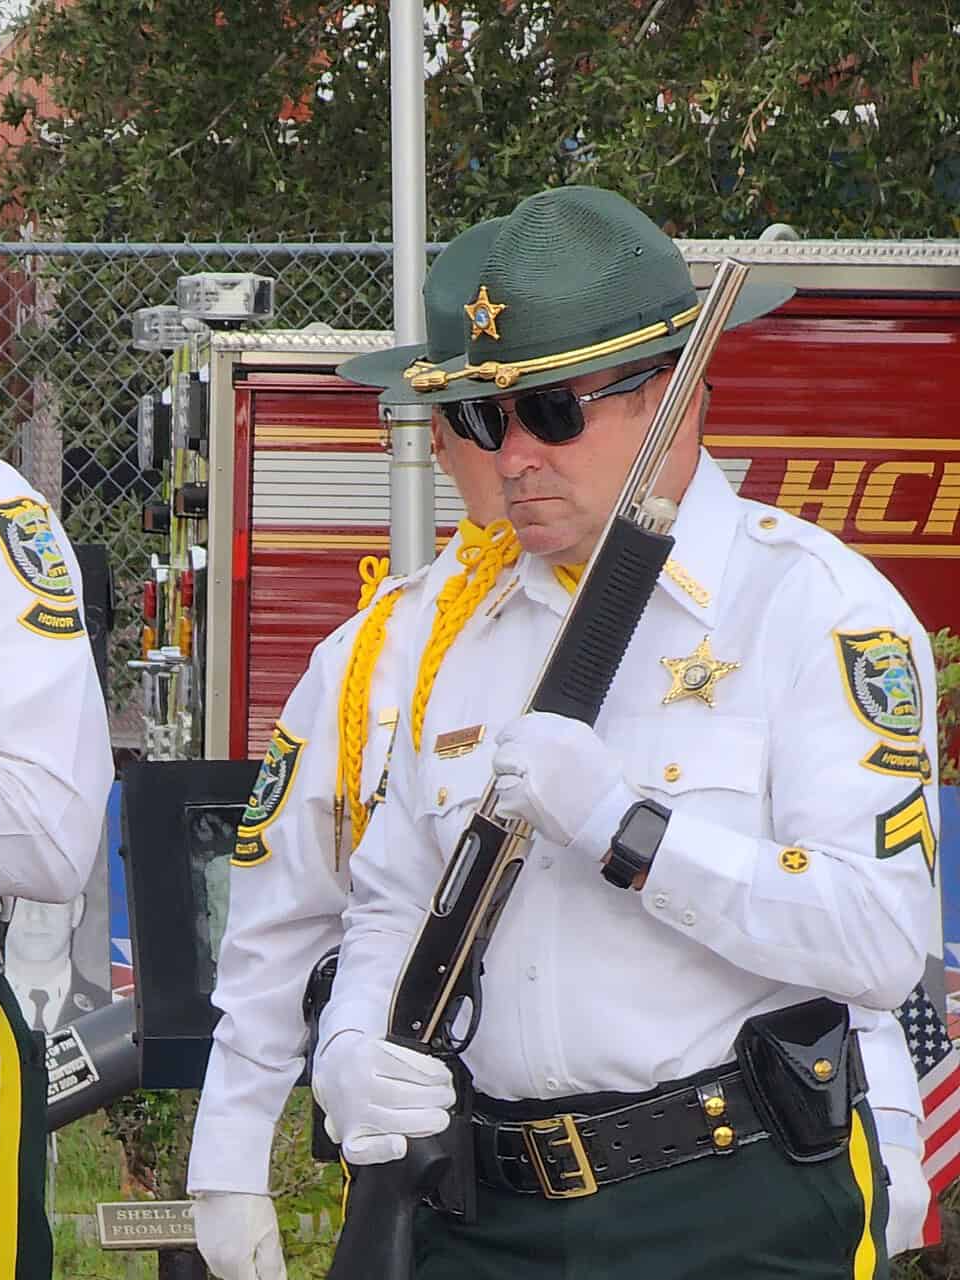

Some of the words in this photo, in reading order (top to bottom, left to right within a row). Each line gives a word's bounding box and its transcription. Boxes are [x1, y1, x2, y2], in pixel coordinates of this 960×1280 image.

[776, 459, 960, 535] HC
[38, 612, 75, 628] HONOR
[882, 752, 918, 767] HONOR
[116, 1208, 177, 1220] SHELL
[112, 1224, 163, 1236] FROM
